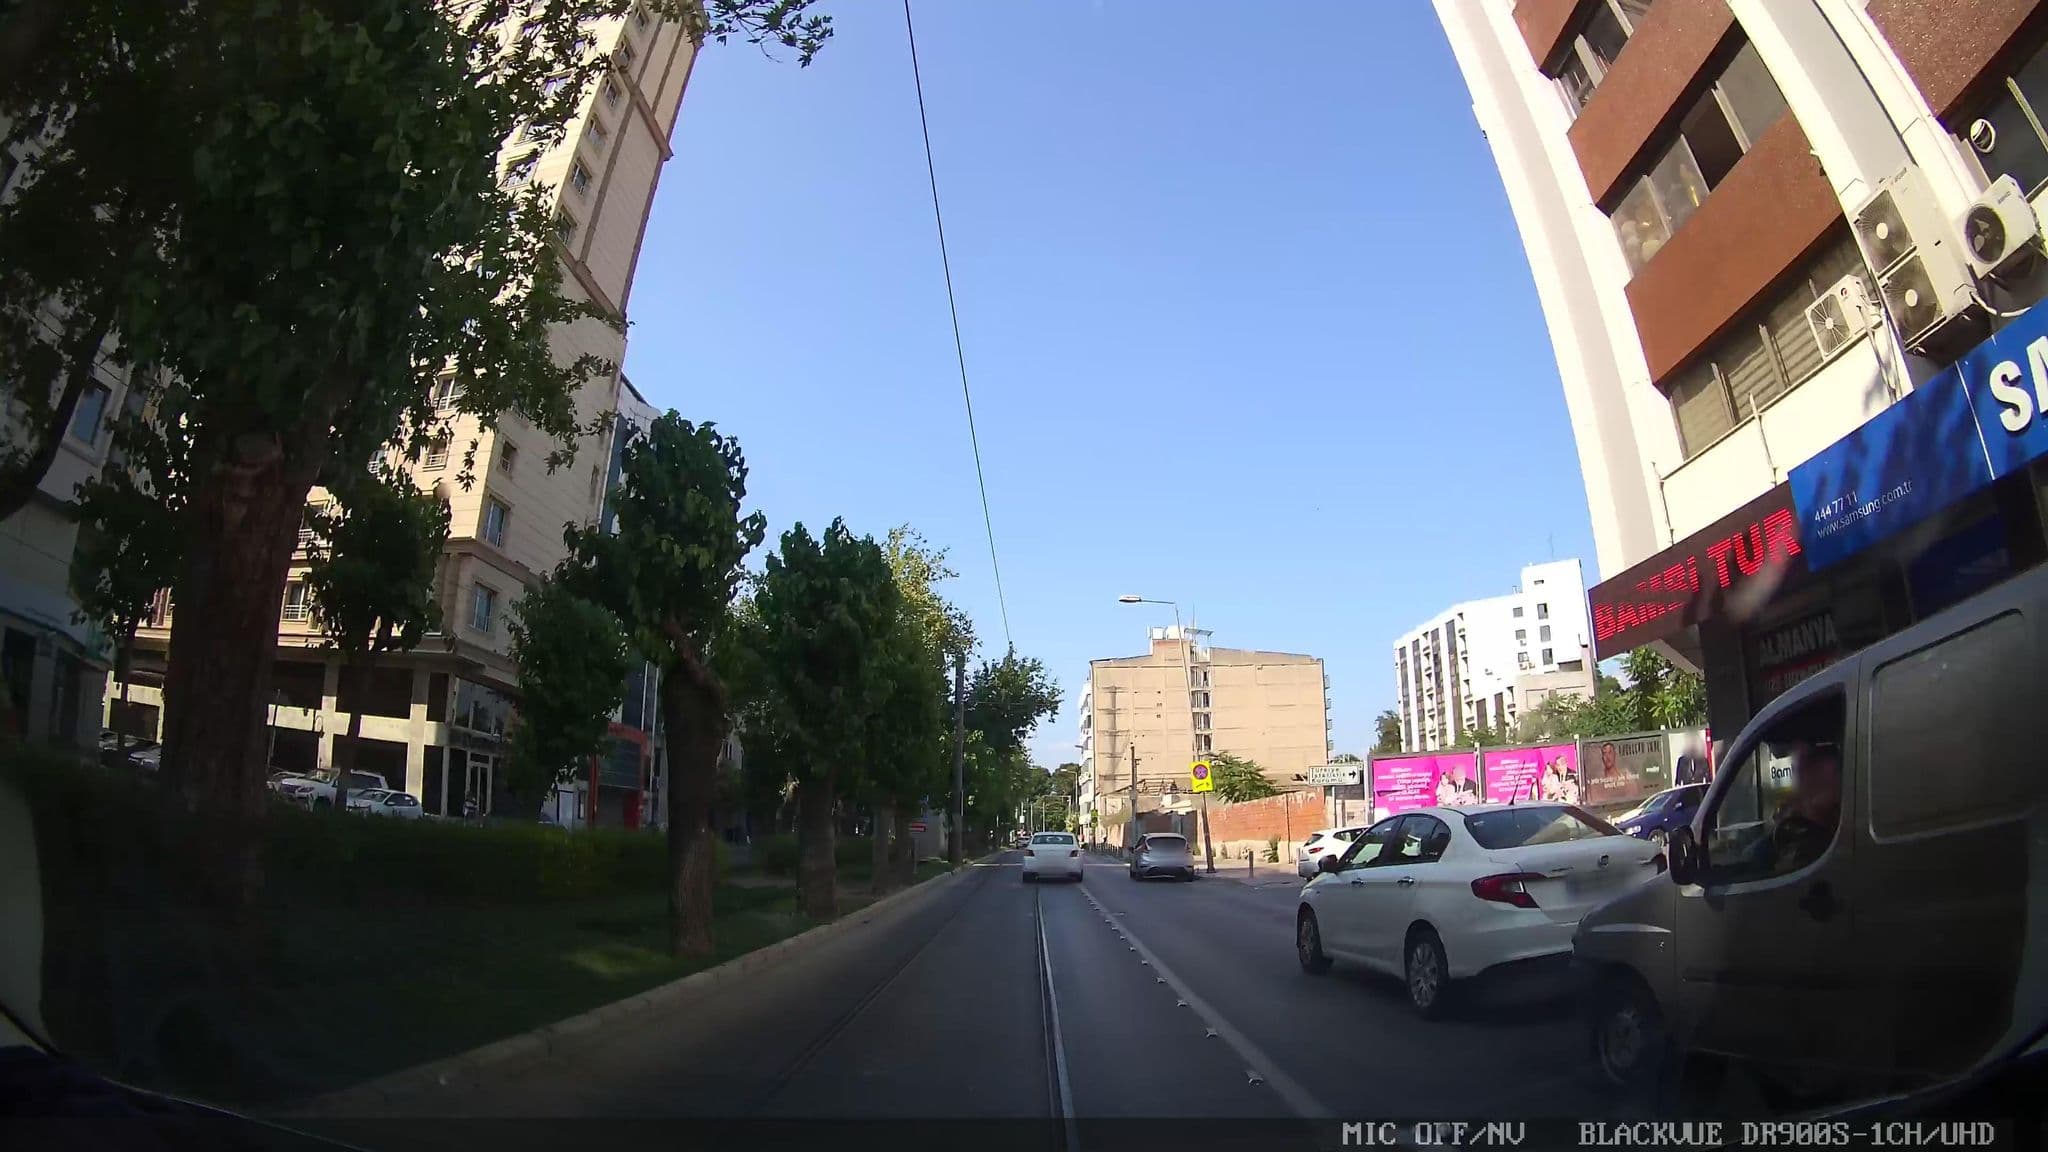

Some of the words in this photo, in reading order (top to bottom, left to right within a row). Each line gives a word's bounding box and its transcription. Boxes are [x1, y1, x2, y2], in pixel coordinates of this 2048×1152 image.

[1814, 504, 1832, 522] 444
[1832, 497, 1844, 514] 77
[1845, 490, 1858, 506] 11
[1816, 480, 1913, 539] www.samsung.com.tr
[1706, 508, 1802, 588] TUR
